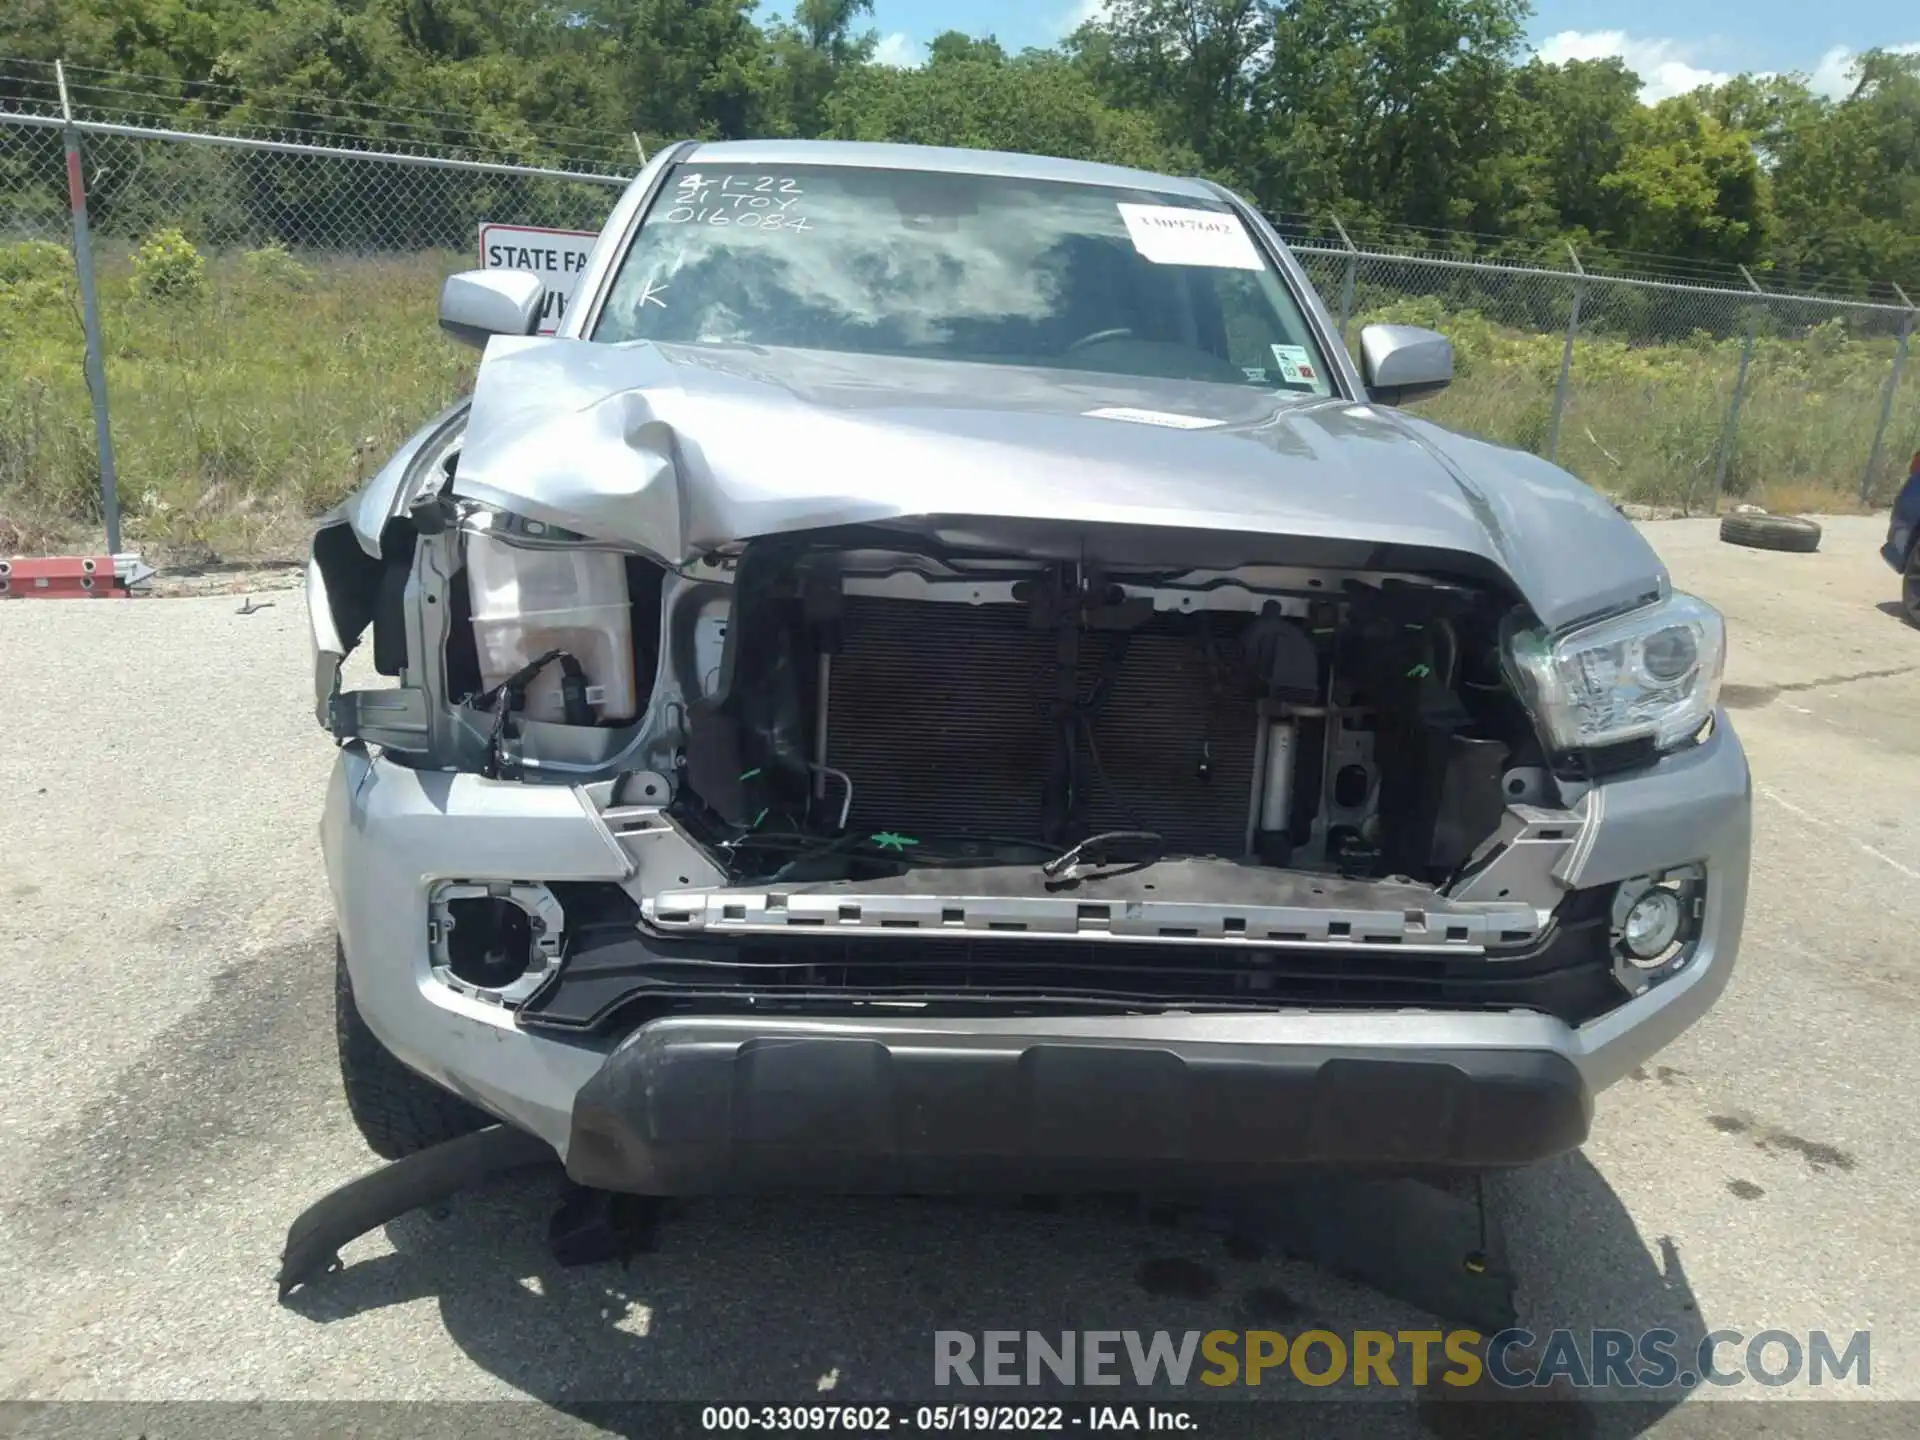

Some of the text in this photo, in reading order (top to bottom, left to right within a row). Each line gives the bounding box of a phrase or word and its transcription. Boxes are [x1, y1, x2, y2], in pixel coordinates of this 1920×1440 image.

[675, 190, 709, 204] 21
[666, 207, 815, 234] 016084
[489, 245, 558, 272] STATE
[639, 279, 670, 308] K
